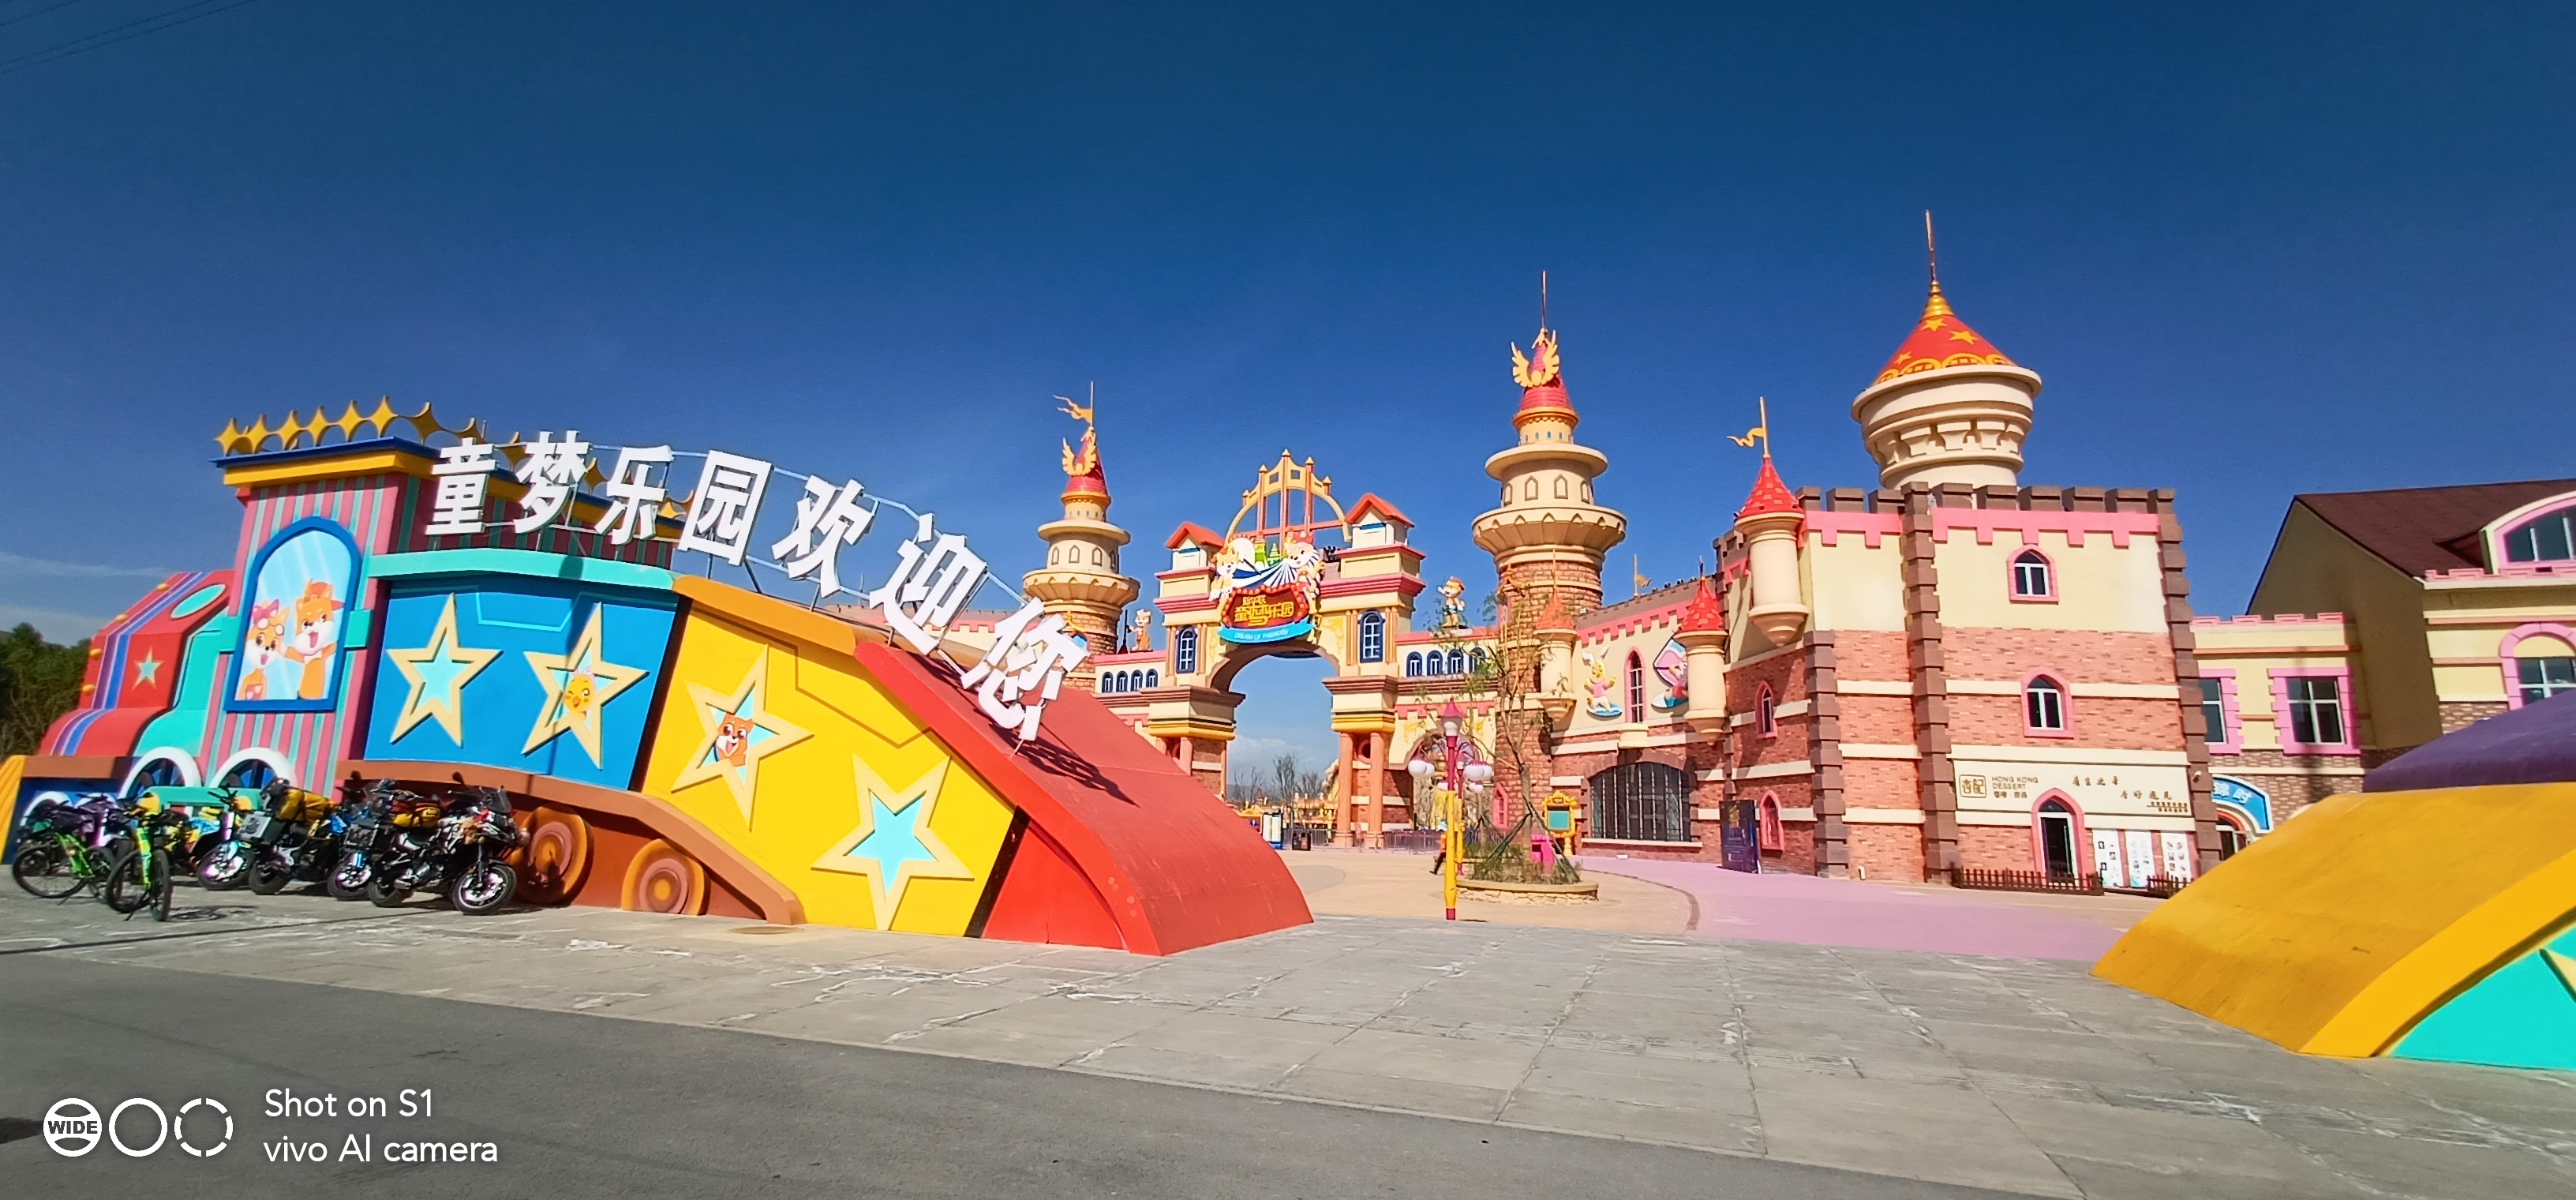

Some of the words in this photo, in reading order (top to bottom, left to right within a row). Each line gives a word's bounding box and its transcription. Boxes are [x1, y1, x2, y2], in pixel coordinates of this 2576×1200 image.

[425, 430, 1092, 741] 童梦乐园欢迎您
